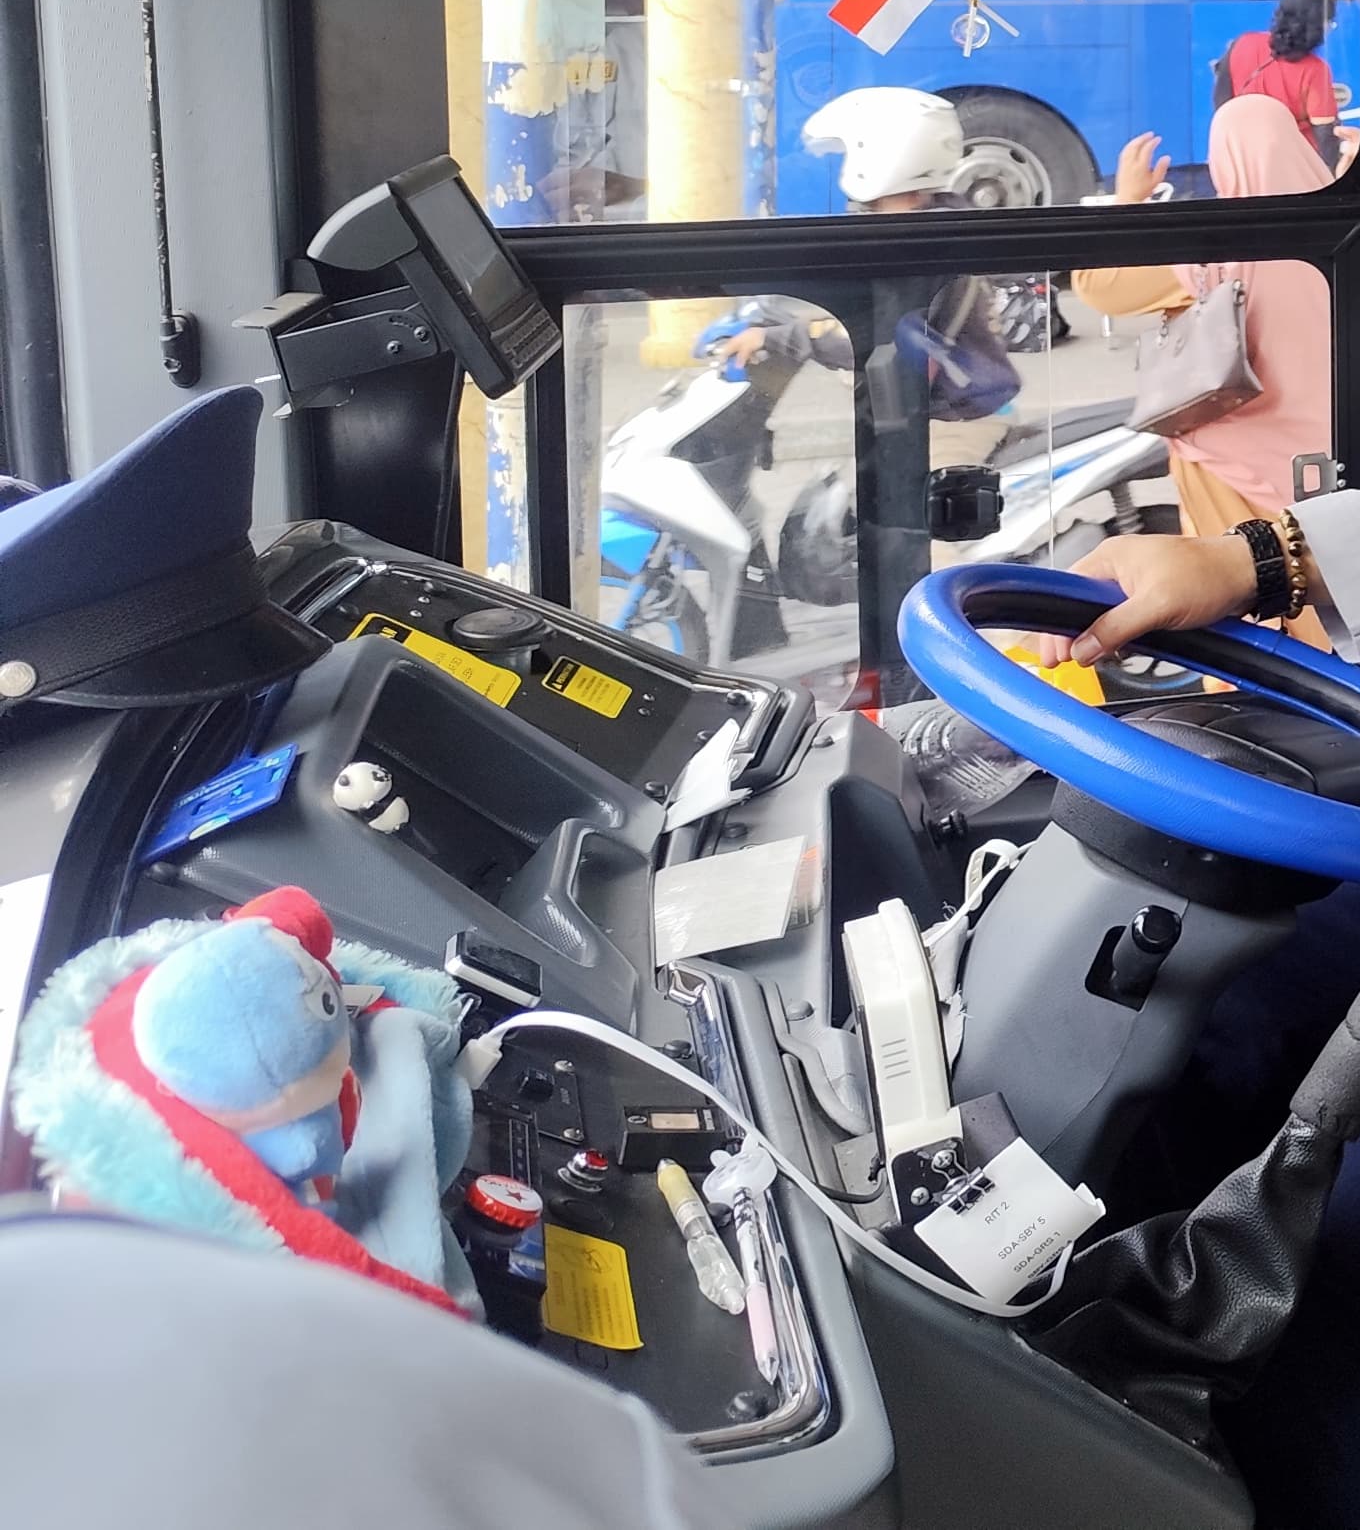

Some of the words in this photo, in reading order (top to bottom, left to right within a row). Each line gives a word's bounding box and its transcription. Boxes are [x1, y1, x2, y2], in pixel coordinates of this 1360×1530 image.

[985, 1207, 1001, 1225] RIT
[1001, 1201, 1010, 1211] 2
[998, 1222, 1037, 1260] SDA-SBY
[1037, 1215, 1047, 1225] 5
